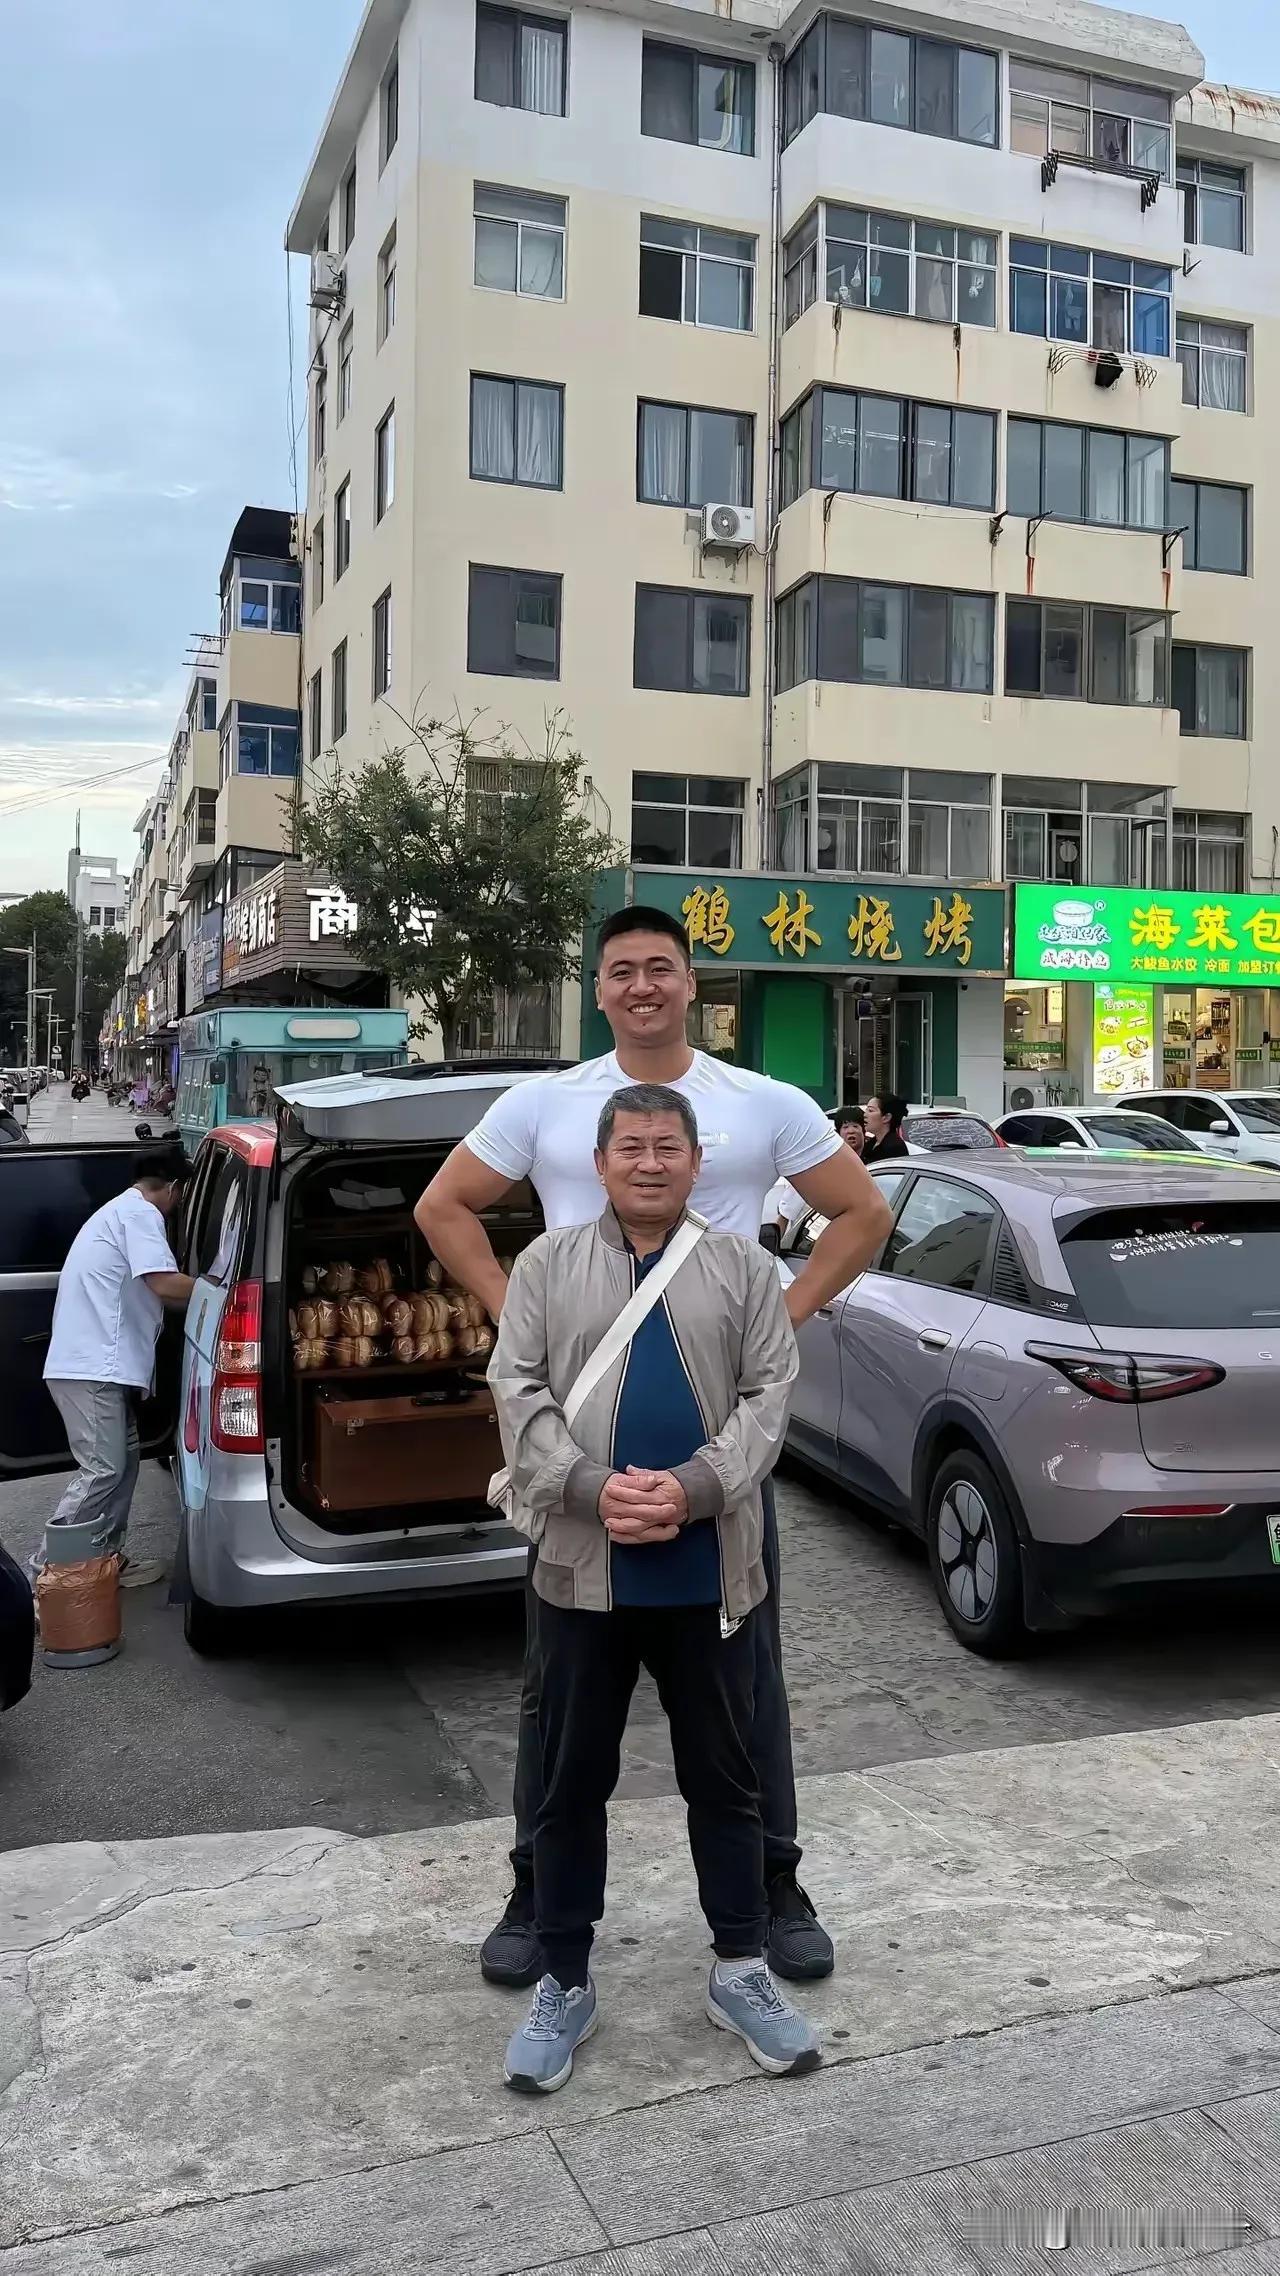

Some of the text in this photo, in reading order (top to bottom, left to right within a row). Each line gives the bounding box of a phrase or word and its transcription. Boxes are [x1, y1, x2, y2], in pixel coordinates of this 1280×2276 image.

[682, 884, 975, 966] 鹤林烧烤
[1129, 904, 1280, 953] 海菜包
[1205, 959, 1230, 973] 冷面
